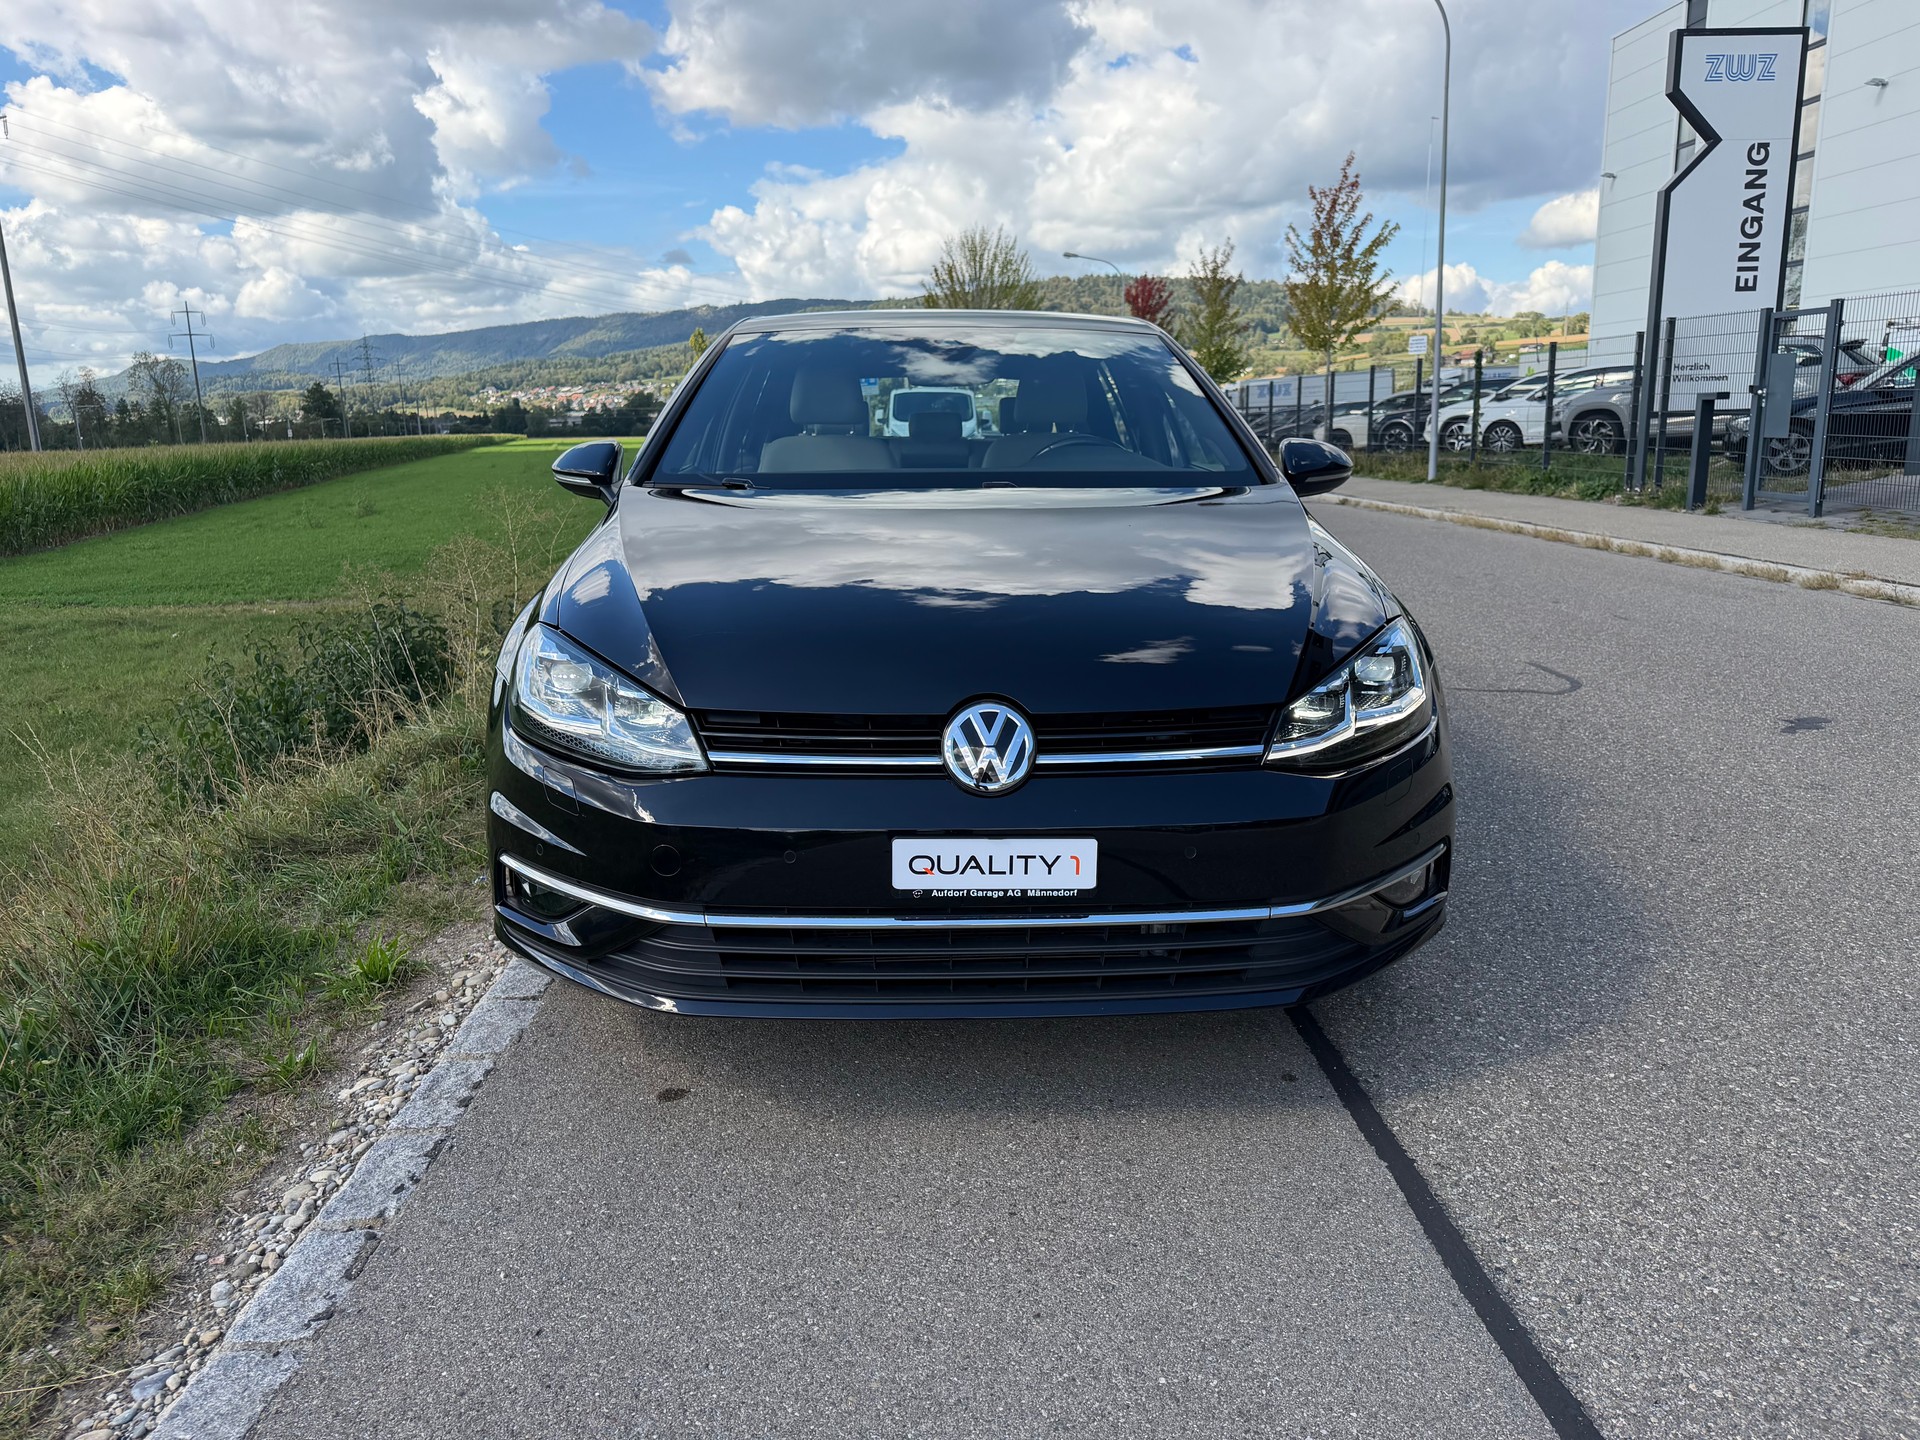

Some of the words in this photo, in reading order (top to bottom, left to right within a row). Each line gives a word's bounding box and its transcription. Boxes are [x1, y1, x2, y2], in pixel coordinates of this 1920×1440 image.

[1734, 142, 1771, 292] EINGANG
[1673, 362, 1710, 371] Herzlich
[1672, 374, 1729, 382] Willkommen
[908, 855, 1061, 875] QUALITY
[1070, 855, 1081, 875] 1
[931, 889, 967, 897] Aufdorf
[969, 889, 1004, 898] Garage
[1006, 889, 1022, 897] AG
[1027, 889, 1078, 897] Männedorf
